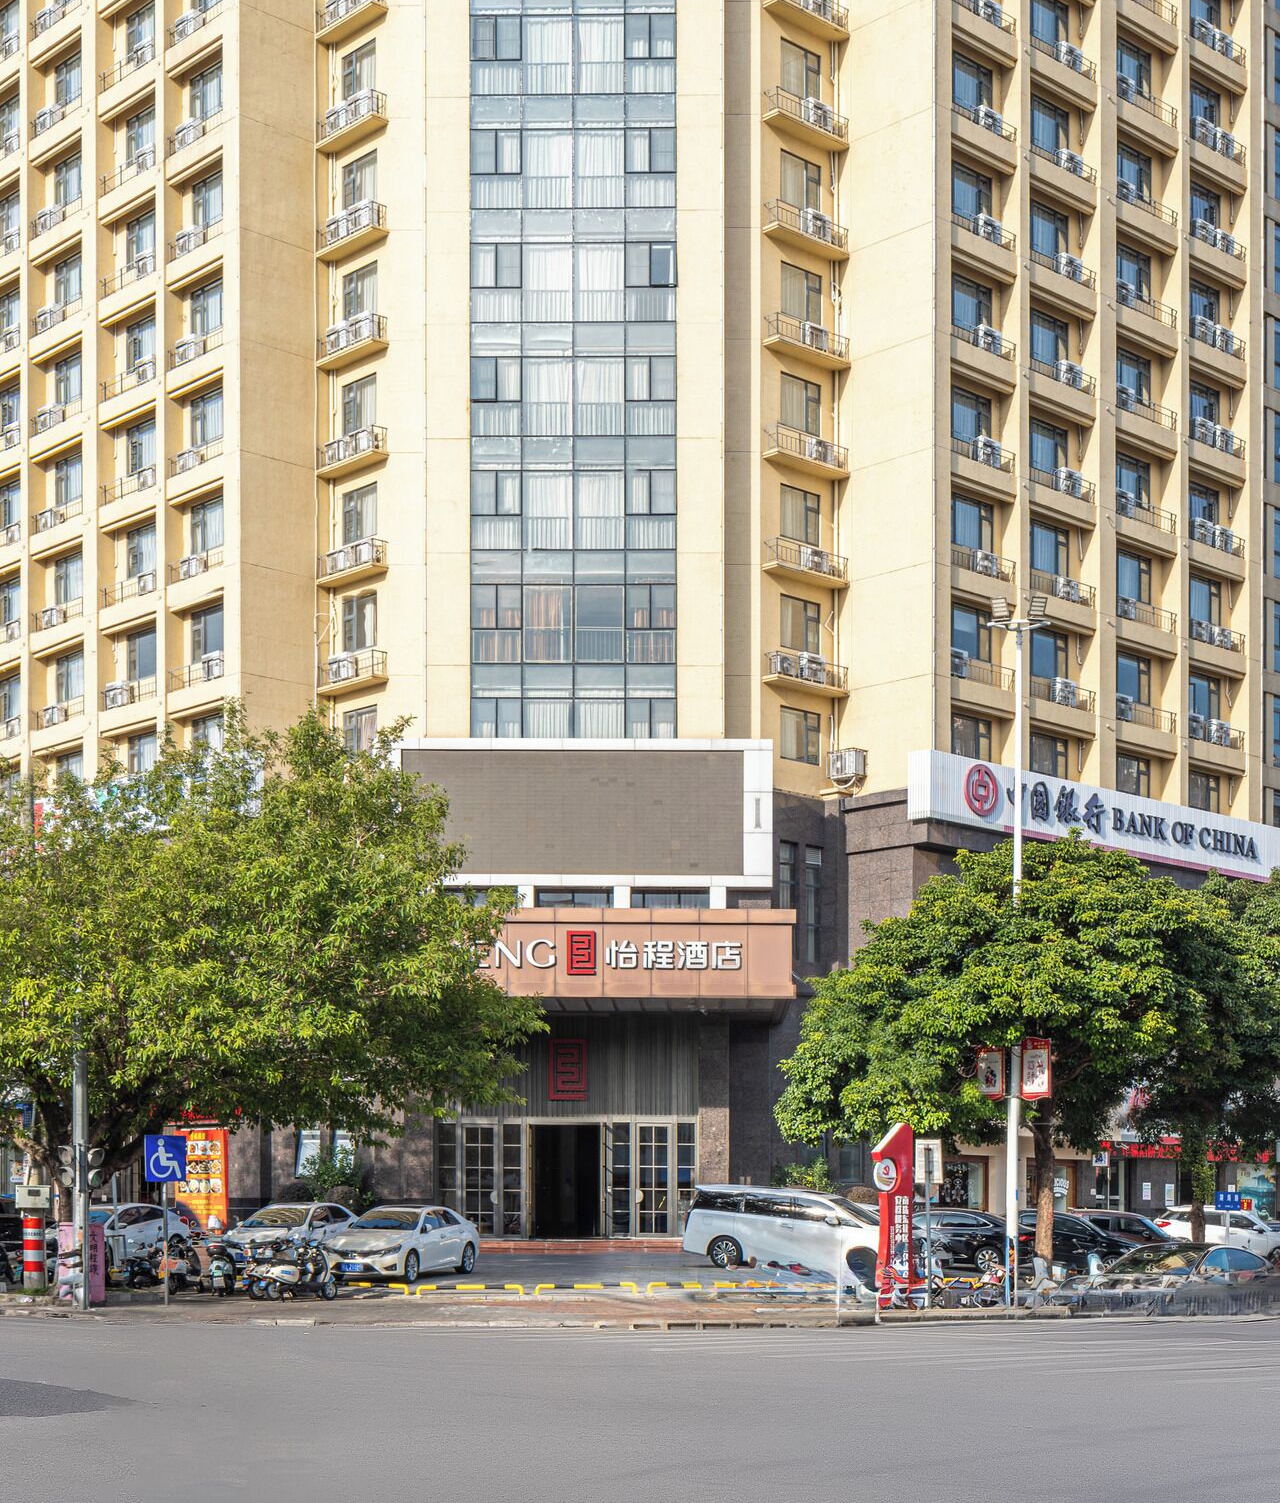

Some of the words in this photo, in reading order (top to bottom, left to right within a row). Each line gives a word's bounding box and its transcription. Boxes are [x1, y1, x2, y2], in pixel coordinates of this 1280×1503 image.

[1112, 807, 1167, 841] BANK
[1172, 821, 1194, 845] OF
[1199, 827, 1259, 859] CHINA
[605, 939, 743, 970] 怡程酒店
